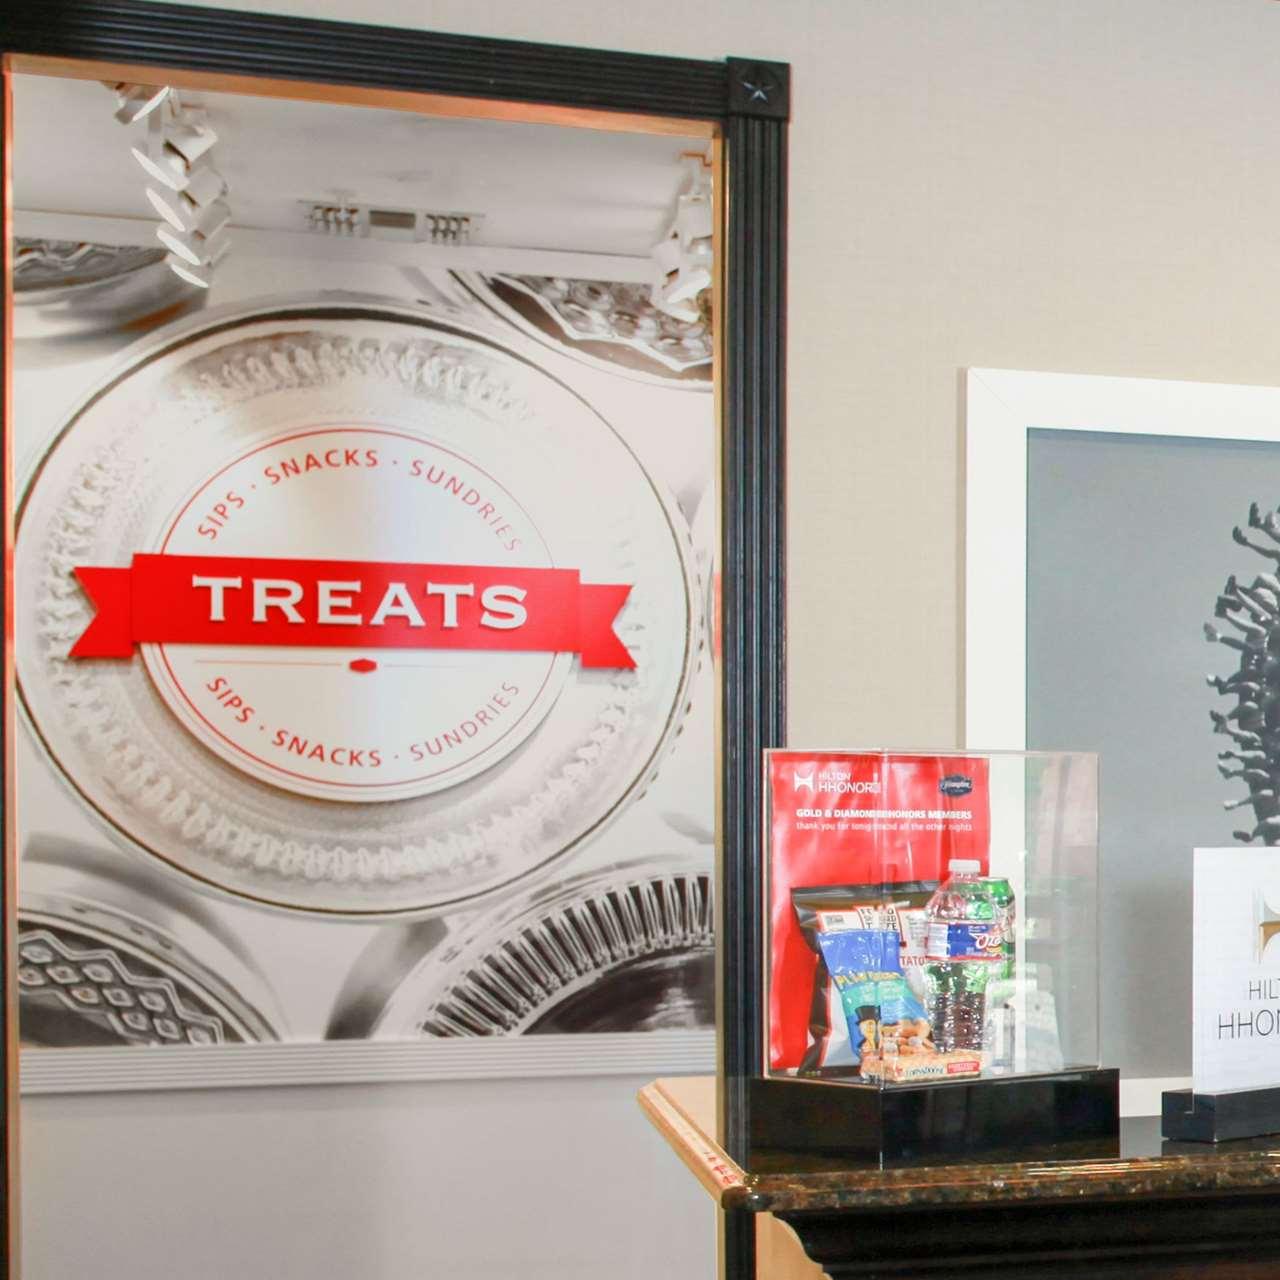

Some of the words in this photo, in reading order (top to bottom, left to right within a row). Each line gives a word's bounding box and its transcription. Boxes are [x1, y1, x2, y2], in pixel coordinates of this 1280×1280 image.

[198, 490, 245, 540] SIPS
[264, 449, 379, 485] SNACKS
[410, 459, 522, 551] SUNDRIES
[192, 574, 528, 629] TREATS
[207, 677, 255, 724] SIPS
[272, 729, 381, 768] SNACKS
[410, 681, 520, 762] SUNDRIES
[818, 771, 851, 781] HILTON
[796, 808, 822, 818] GOLD
[900, 955, 925, 966] TATO
